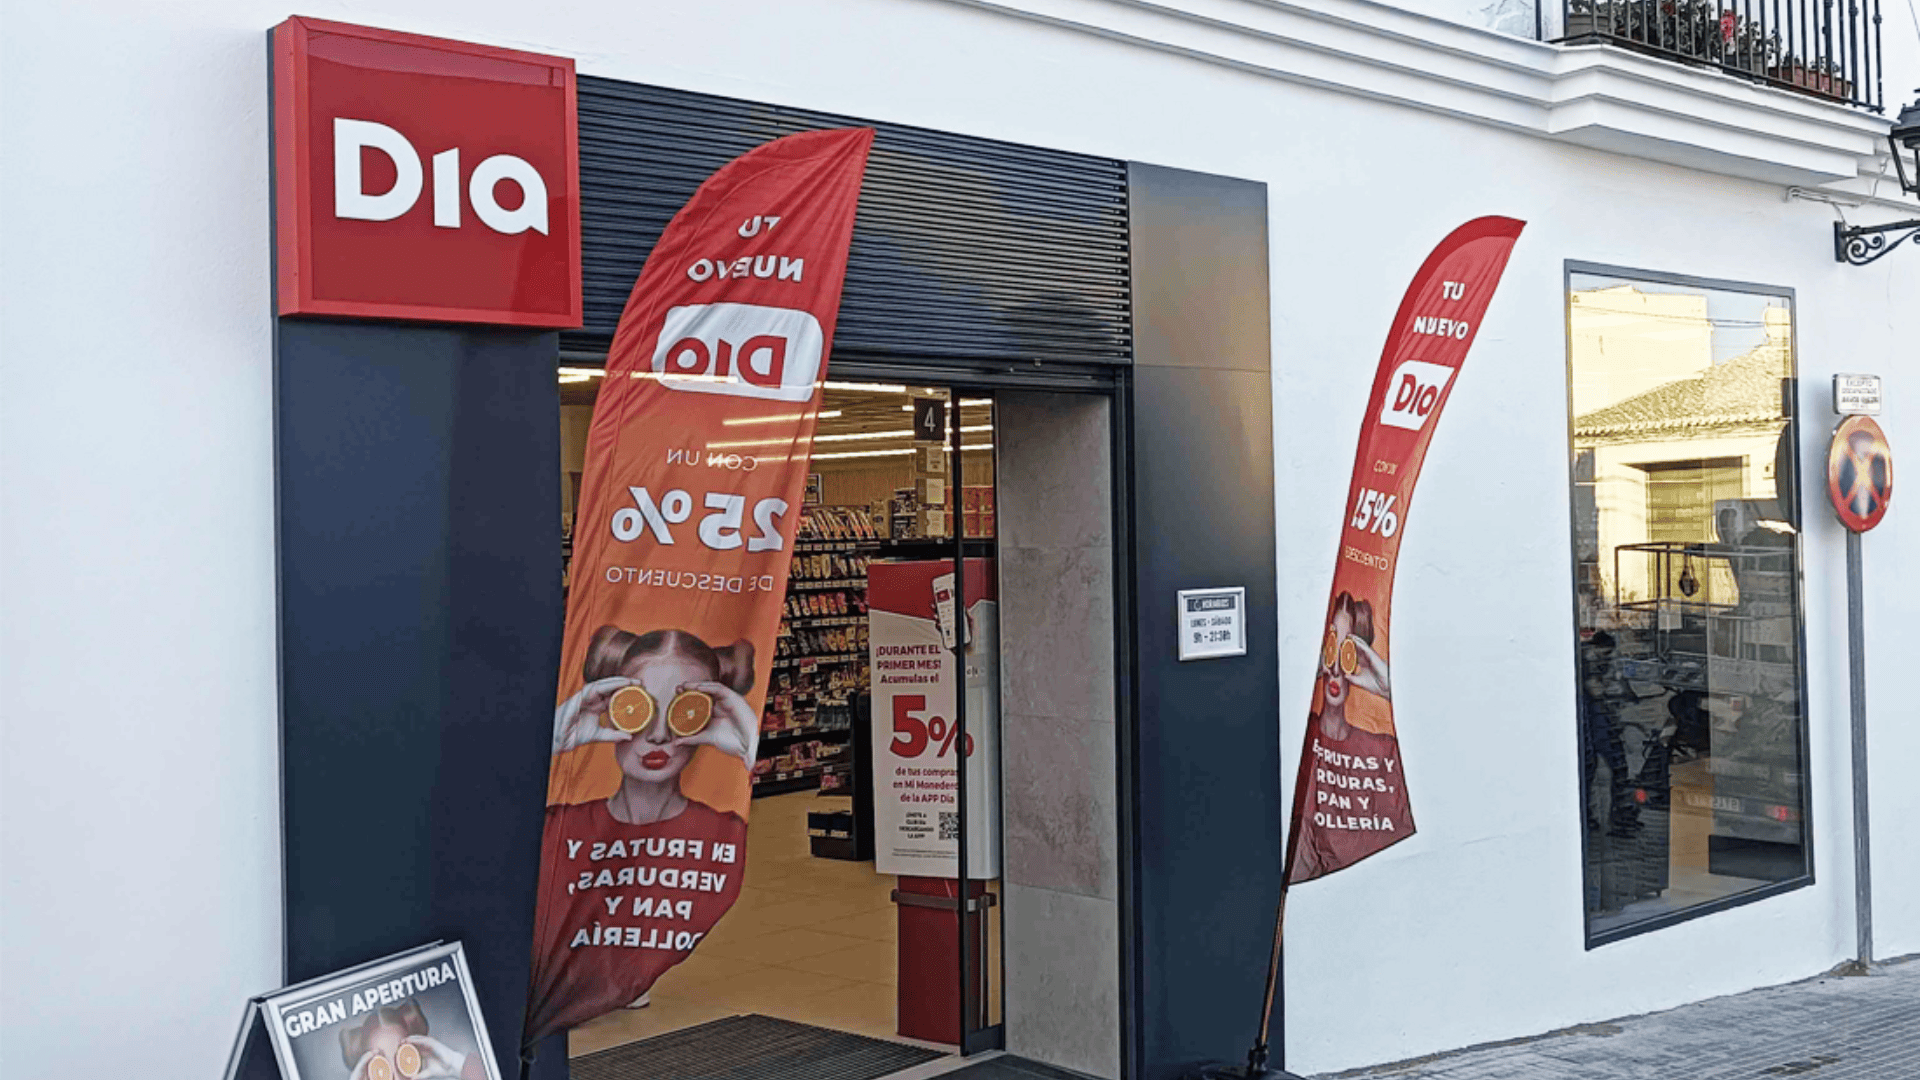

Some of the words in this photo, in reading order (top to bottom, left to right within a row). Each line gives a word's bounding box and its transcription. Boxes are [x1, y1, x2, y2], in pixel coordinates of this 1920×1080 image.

[333, 117, 549, 236] Dia
[1443, 281, 1465, 300] TU
[1413, 316, 1469, 340] NUEVO
[924, 406, 937, 432] 4
[929, 644, 941, 654] EL
[877, 660, 915, 670] PRIMER
[880, 673, 929, 684] Acumulas
[889, 694, 975, 758] 5%
[895, 767, 906, 776] de
[1383, 757, 1395, 773] Y
[900, 793, 911, 802] de
[921, 794, 939, 803] APP
[1317, 790, 1352, 810] PAN
[1357, 796, 1370, 810] Y
[284, 998, 347, 1038] GRAN
[351, 960, 456, 1016] APERTURA
